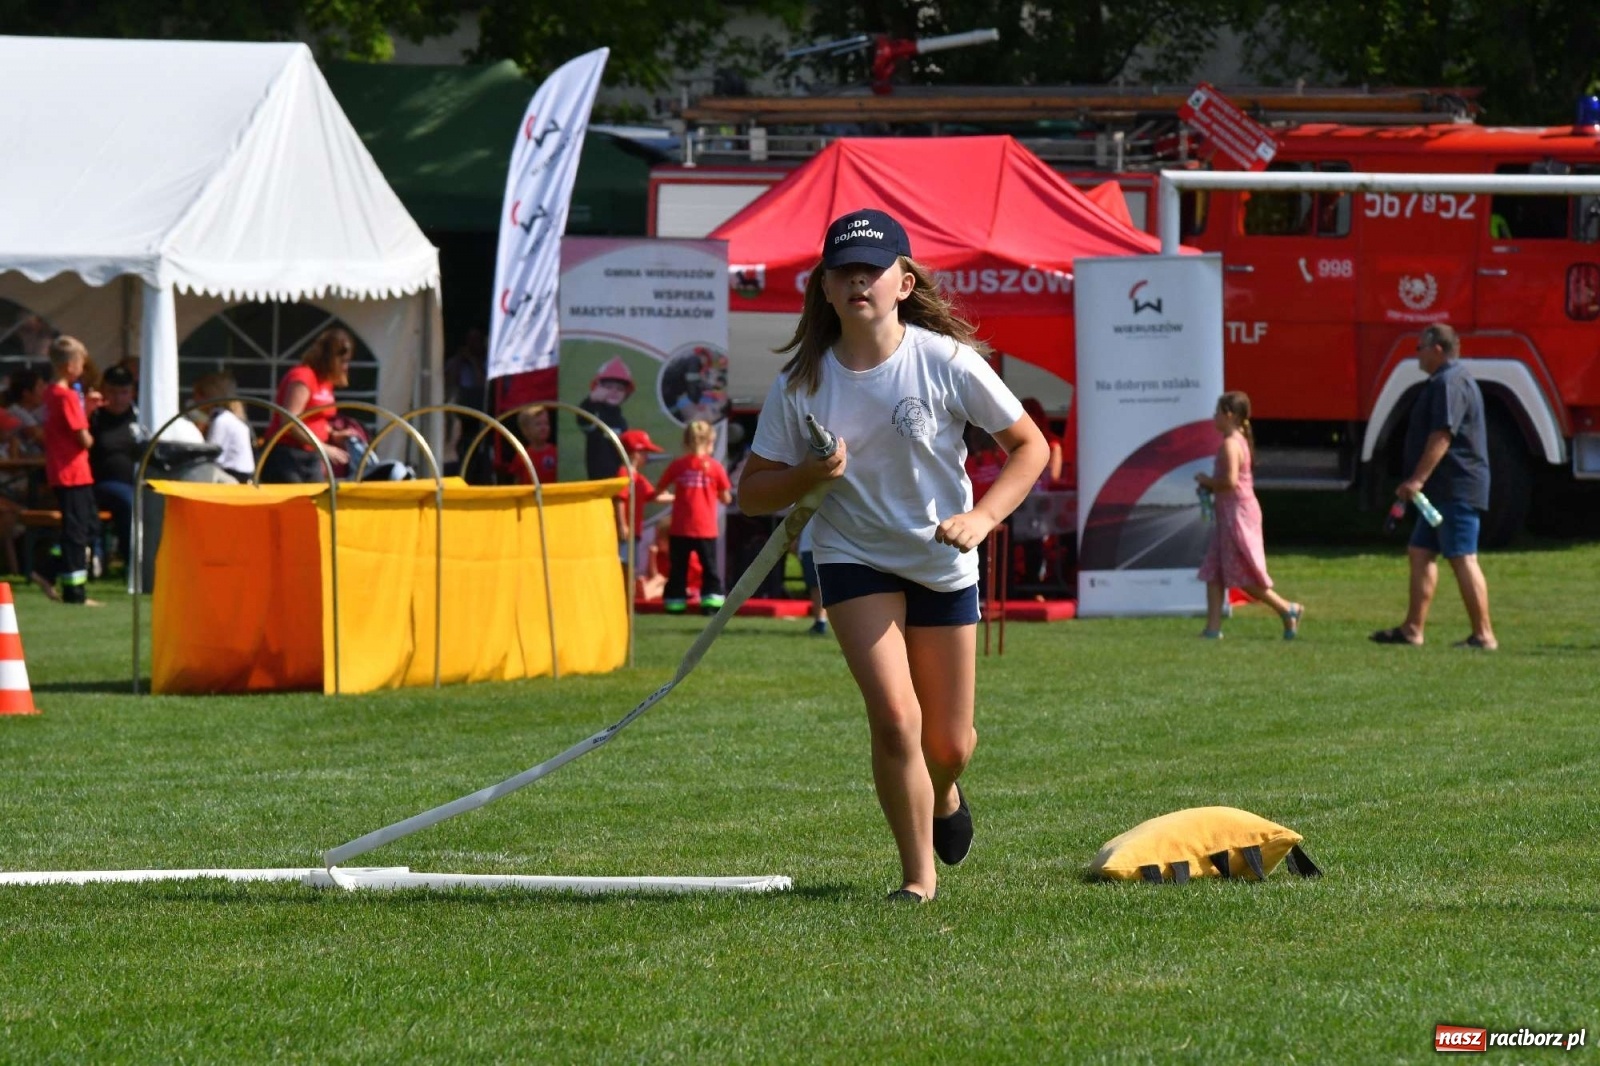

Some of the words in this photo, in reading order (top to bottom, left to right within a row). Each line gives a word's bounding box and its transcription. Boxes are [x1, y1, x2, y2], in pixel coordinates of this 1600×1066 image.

[847, 219, 870, 230] DDP
[834, 228, 884, 244] BOJANÓW
[603, 268, 641, 278] GMINA
[645, 267, 716, 279] WIERUSZÓW
[1318, 260, 1353, 277] 998
[653, 289, 716, 300] WSPIERA
[569, 305, 625, 317] MAŁYCH
[629, 306, 715, 318] STRAŻAKÓW
[1113, 321, 1183, 333] WIERUSZÓW
[1226, 321, 1268, 343] TLF
[1095, 380, 1112, 391] Na
[1114, 379, 1159, 392] dobrym
